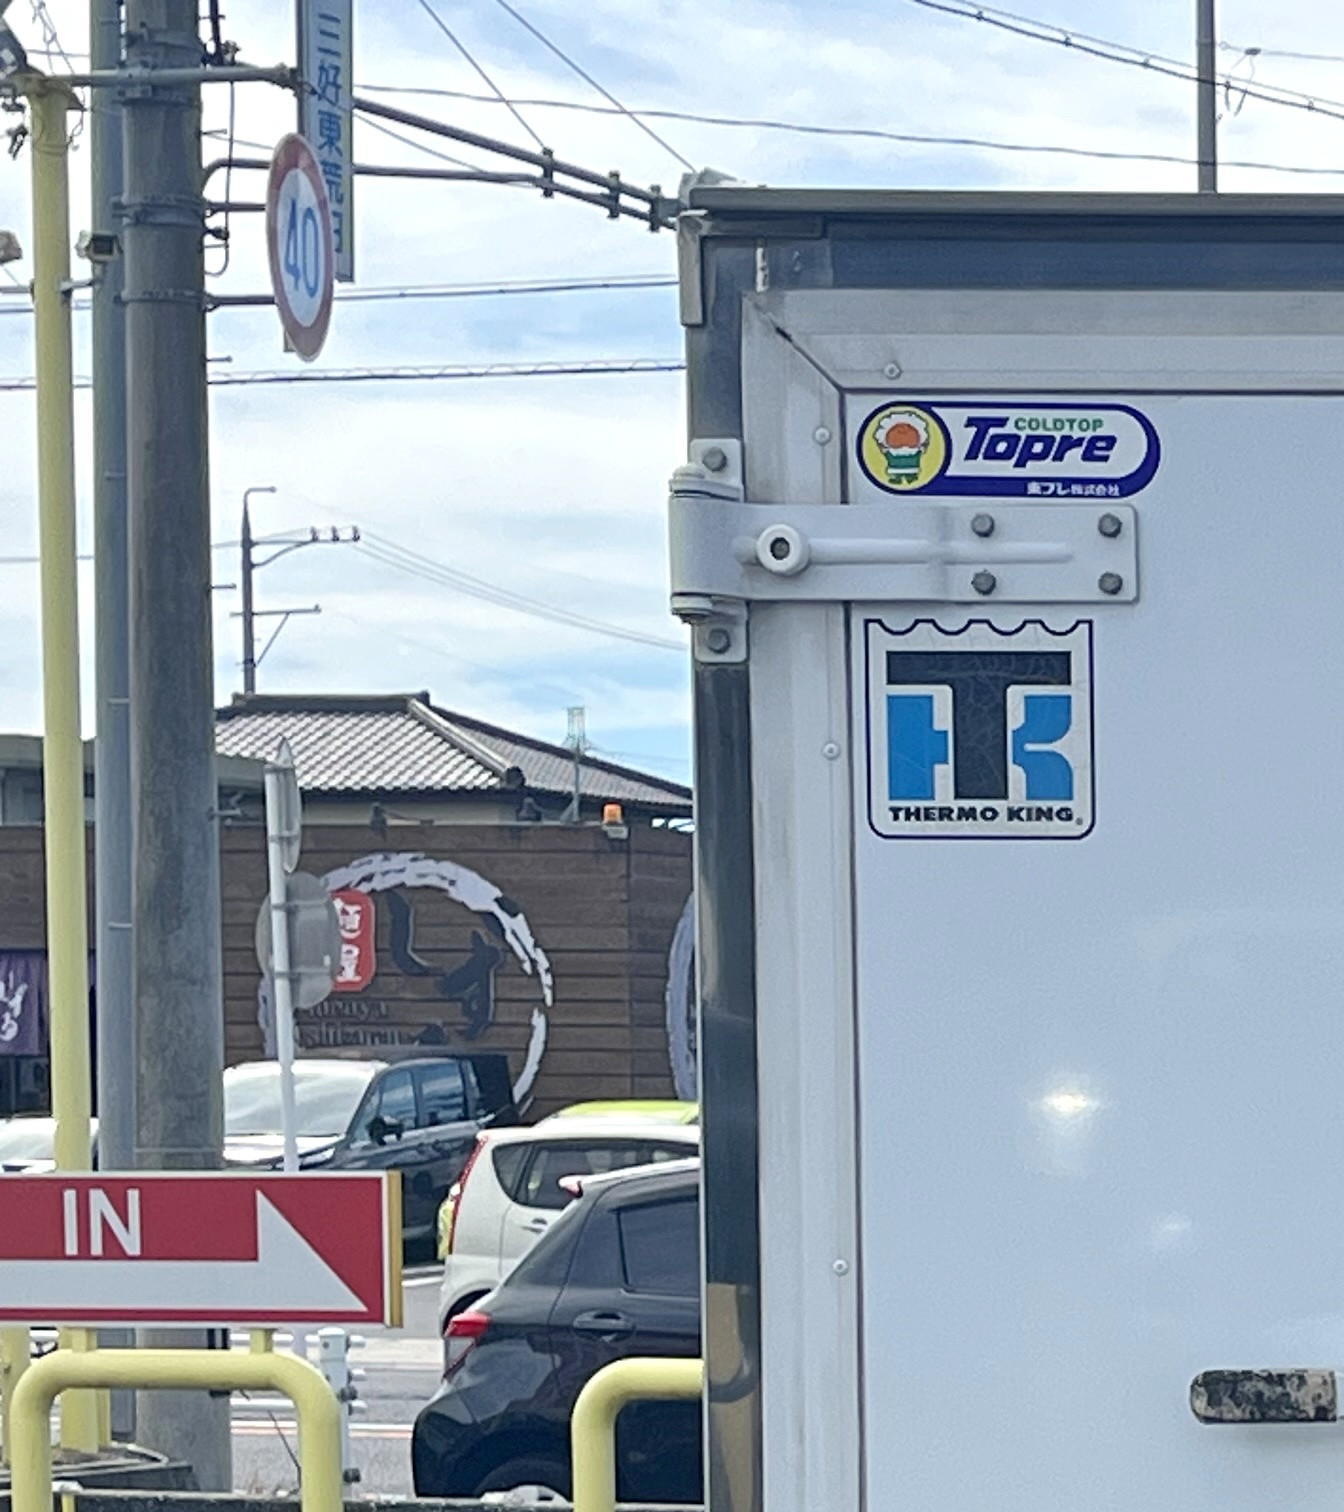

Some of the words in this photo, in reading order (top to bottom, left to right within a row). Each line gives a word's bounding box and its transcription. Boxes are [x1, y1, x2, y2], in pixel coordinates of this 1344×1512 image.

[284, 198, 319, 298] 40
[963, 416, 1118, 468] Topre
[1013, 417, 1104, 432] COLDTOP
[888, 806, 1000, 822] THERMO
[1006, 806, 1074, 822] KING
[63, 1188, 142, 1257] IN
